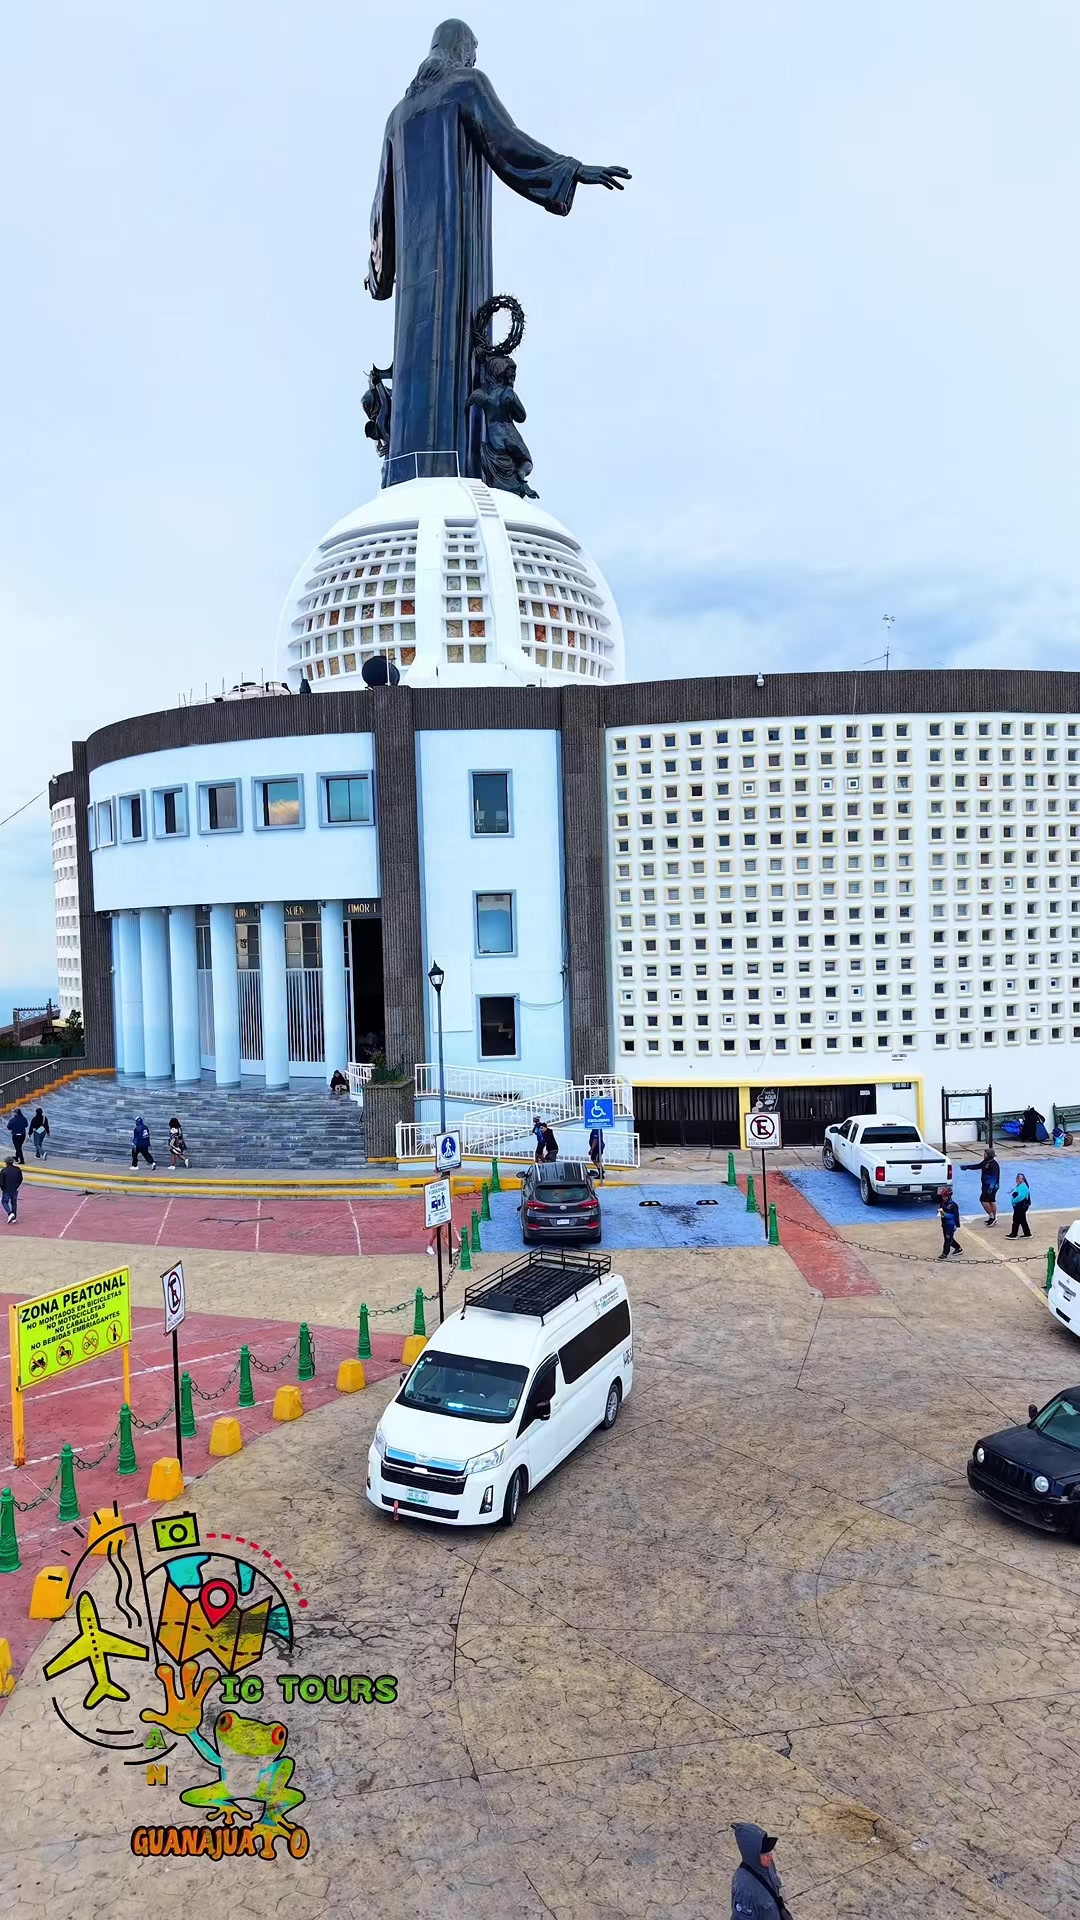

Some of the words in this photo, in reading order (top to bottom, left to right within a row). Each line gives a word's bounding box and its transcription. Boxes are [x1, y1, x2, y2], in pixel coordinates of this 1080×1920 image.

[21, 1298, 59, 1324] ZONA
[63, 1274, 126, 1308] PEATONAL
[26, 1321, 37, 1331] NO
[39, 1307, 75, 1327] MONTADOS
[77, 1304, 86, 1312] EN
[87, 1289, 122, 1308] BICICLETAS
[46, 1321, 57, 1331] NO
[59, 1302, 106, 1326] MOTOCICLETAS
[30, 1341, 41, 1351] NO
[42, 1330, 71, 1347] BEBIDAS
[72, 1310, 120, 1334] EMBRIAGANTES
[54, 1325, 65, 1334] NO
[66, 1312, 99, 1330] CABALLOS
